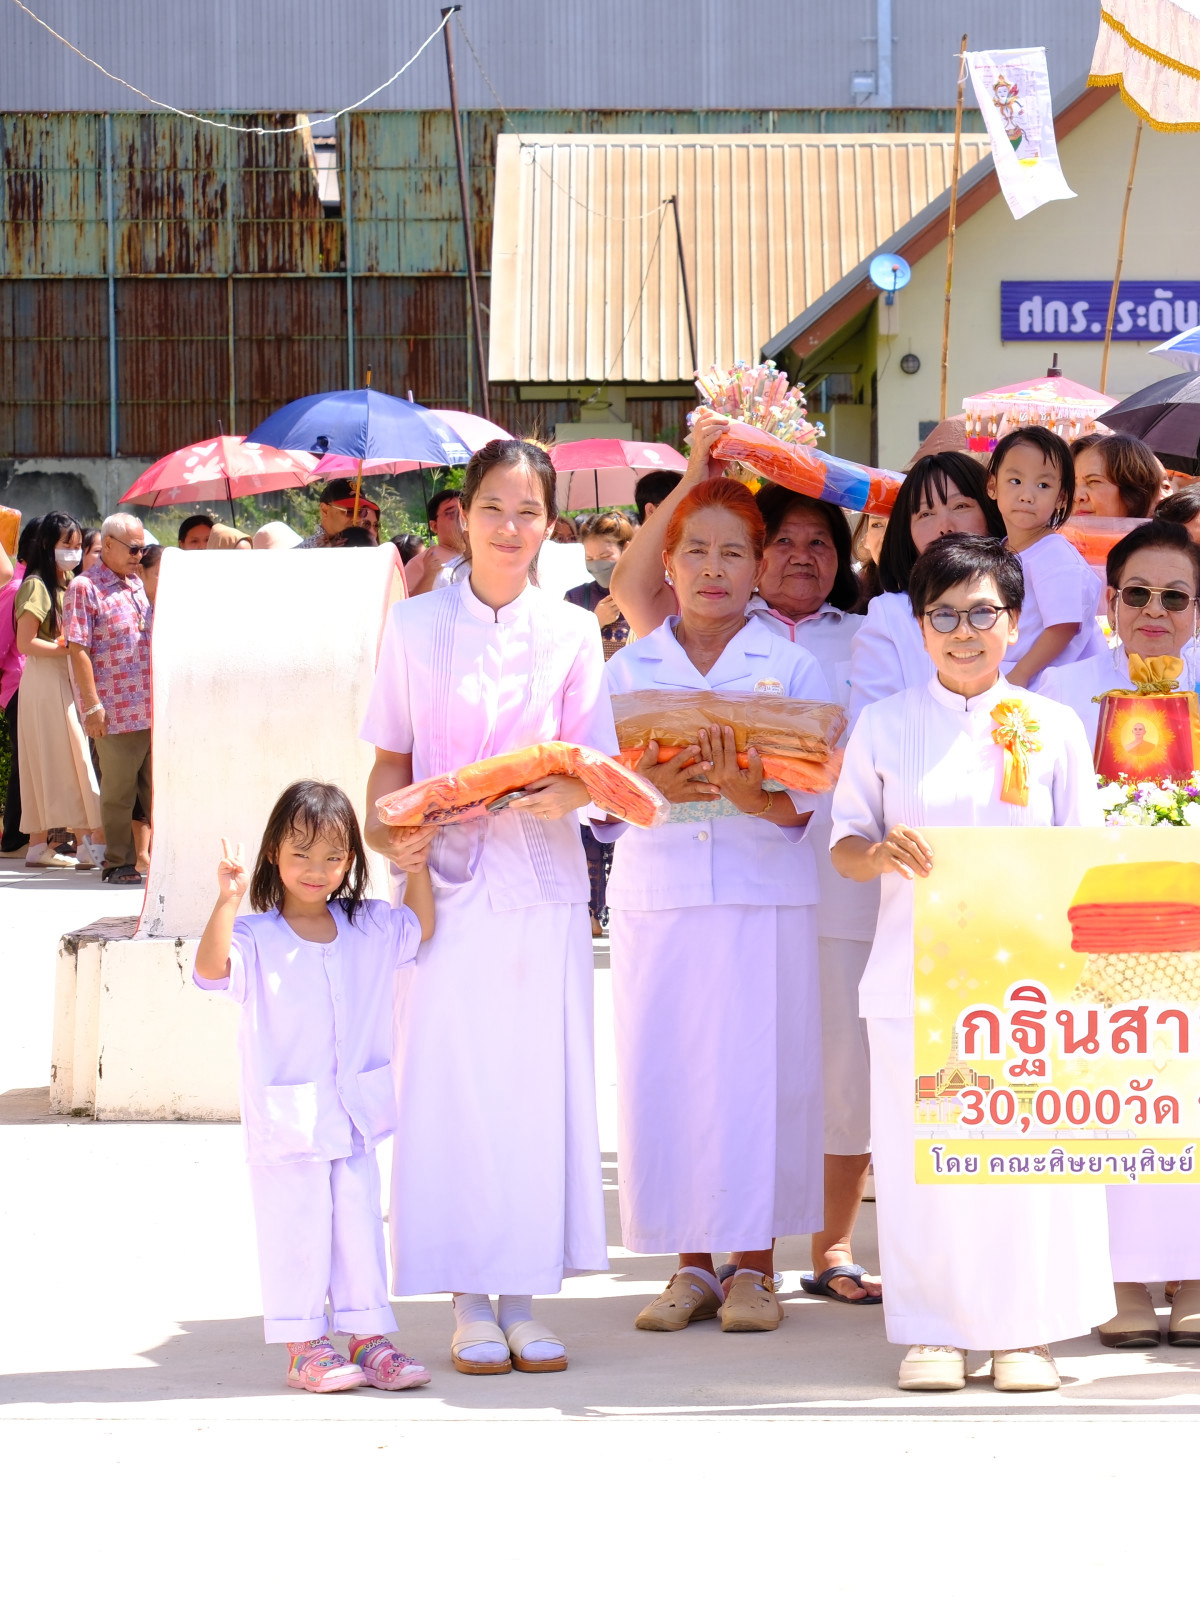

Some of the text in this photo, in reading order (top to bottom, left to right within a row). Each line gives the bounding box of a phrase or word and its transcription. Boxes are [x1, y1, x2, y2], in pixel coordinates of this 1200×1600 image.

[1019, 295, 1102, 333] ศกร.
[960, 1078, 1180, 1134] 30,000วัด
[931, 1146, 979, 1173] โดย
[989, 1145, 1194, 1181] คณะศิษยานุศิษย์
